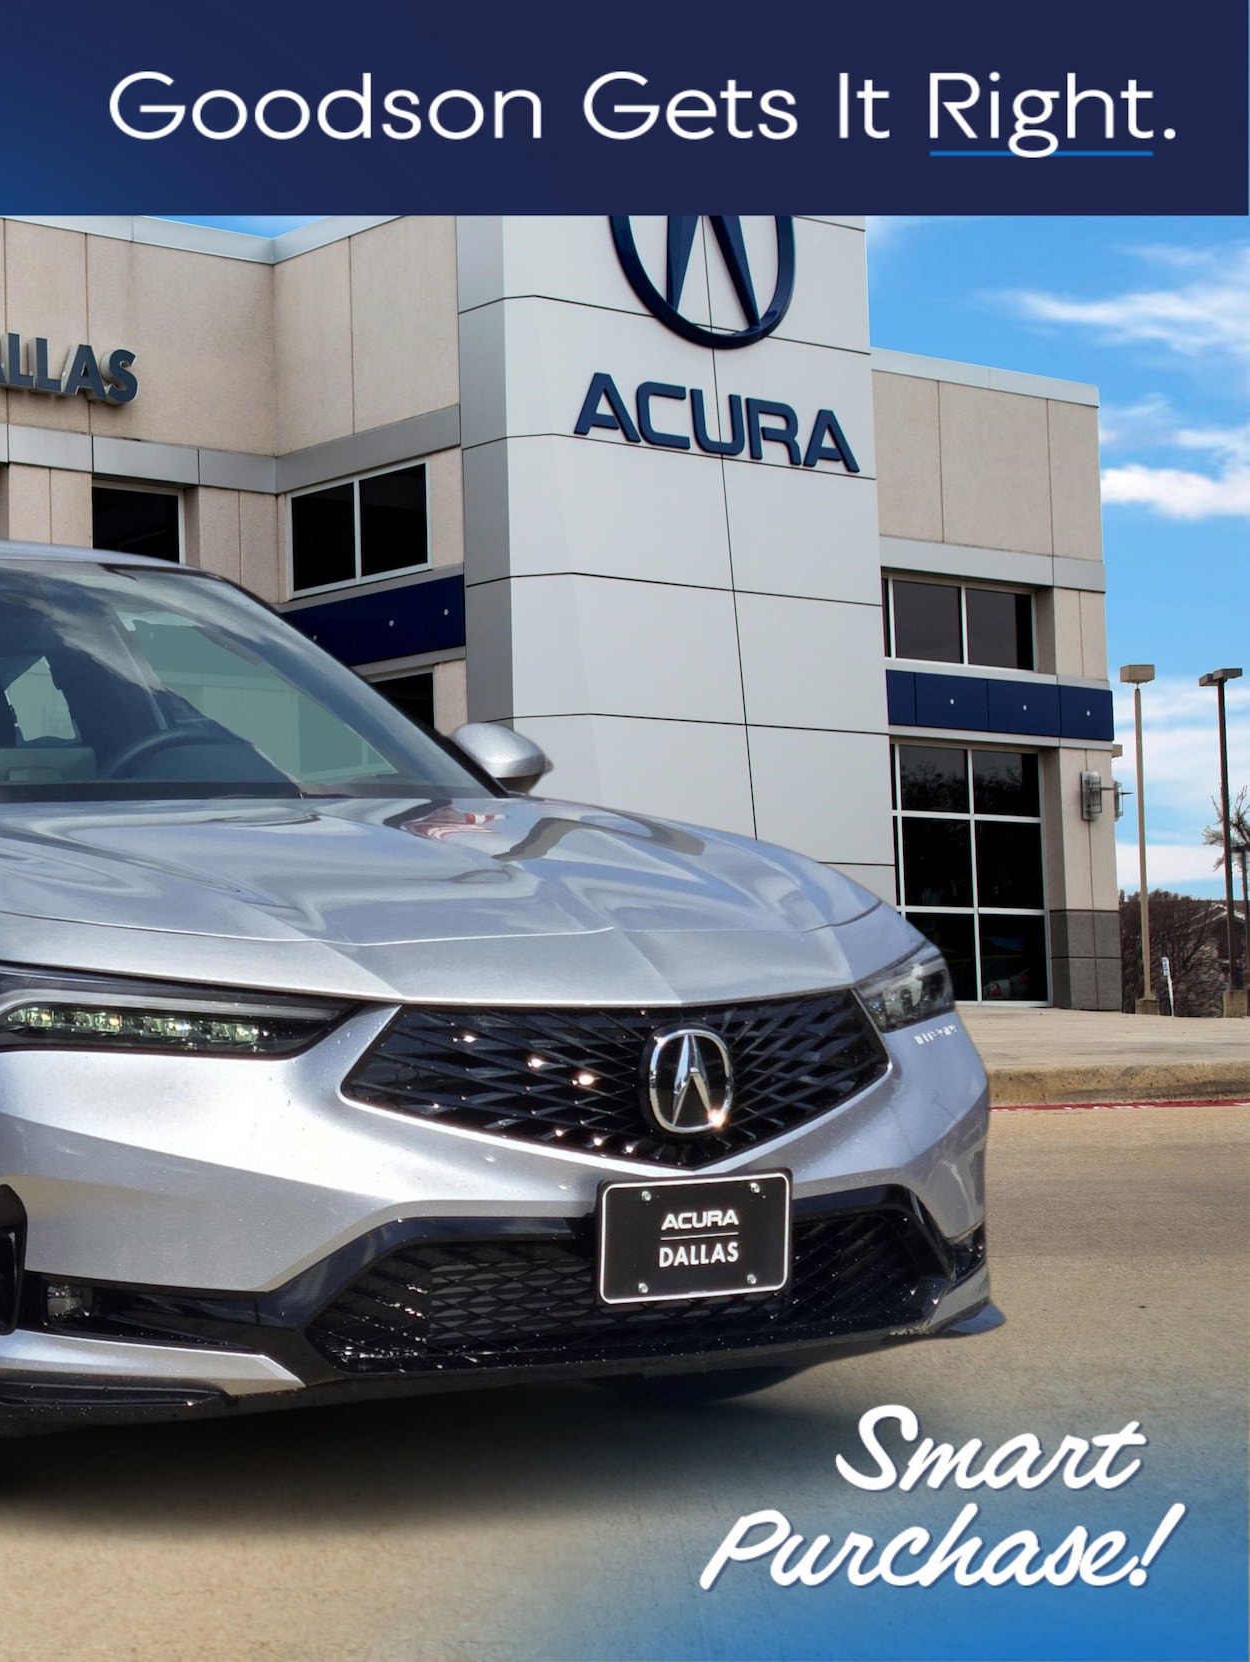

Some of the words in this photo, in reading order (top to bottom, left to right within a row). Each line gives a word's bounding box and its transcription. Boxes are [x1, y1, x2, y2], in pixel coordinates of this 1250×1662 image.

[573, 371, 860, 473] ACURA
[660, 1209, 740, 1231] ACURA
[658, 1241, 740, 1269] DALLAS
